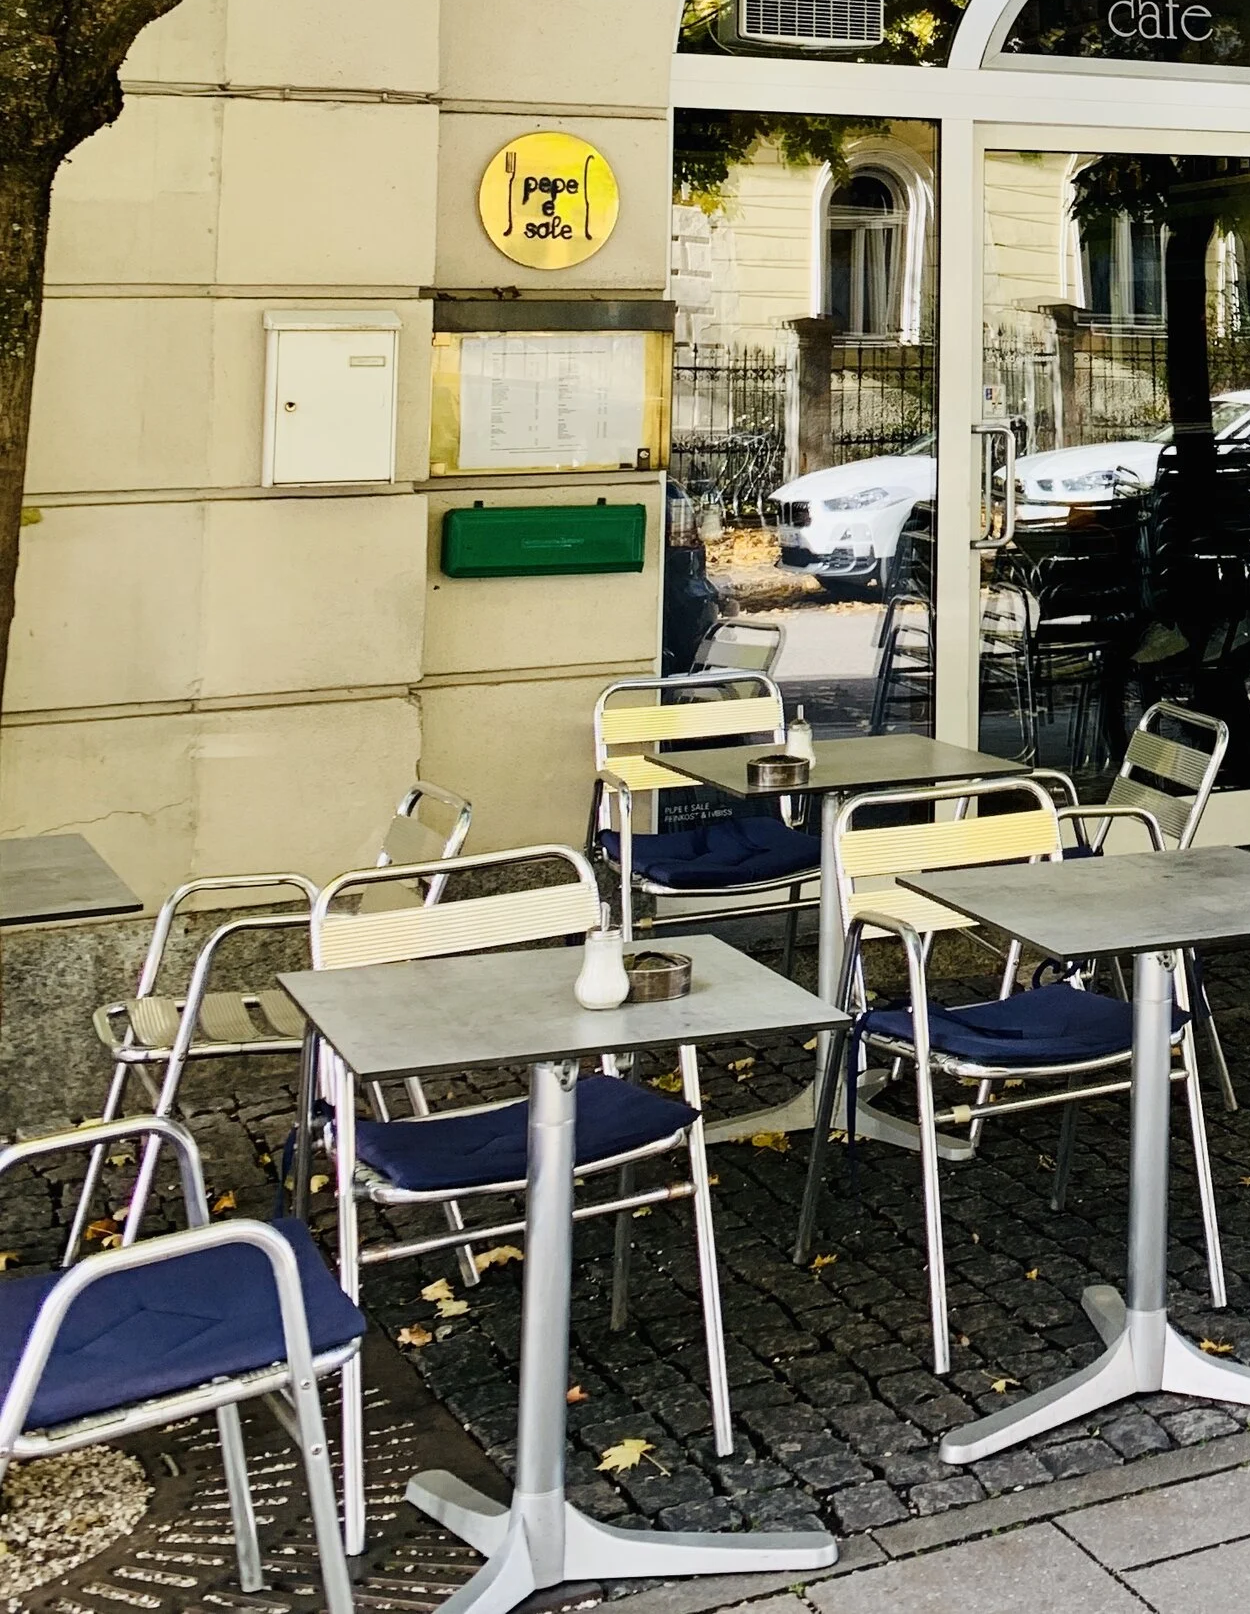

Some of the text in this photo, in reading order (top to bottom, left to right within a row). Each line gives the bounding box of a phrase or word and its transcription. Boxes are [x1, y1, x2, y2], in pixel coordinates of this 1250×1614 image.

[522, 176, 579, 206] pepe
[541, 200, 556, 217] e
[523, 215, 573, 240] sale
[690, 802, 709, 811] SALE
